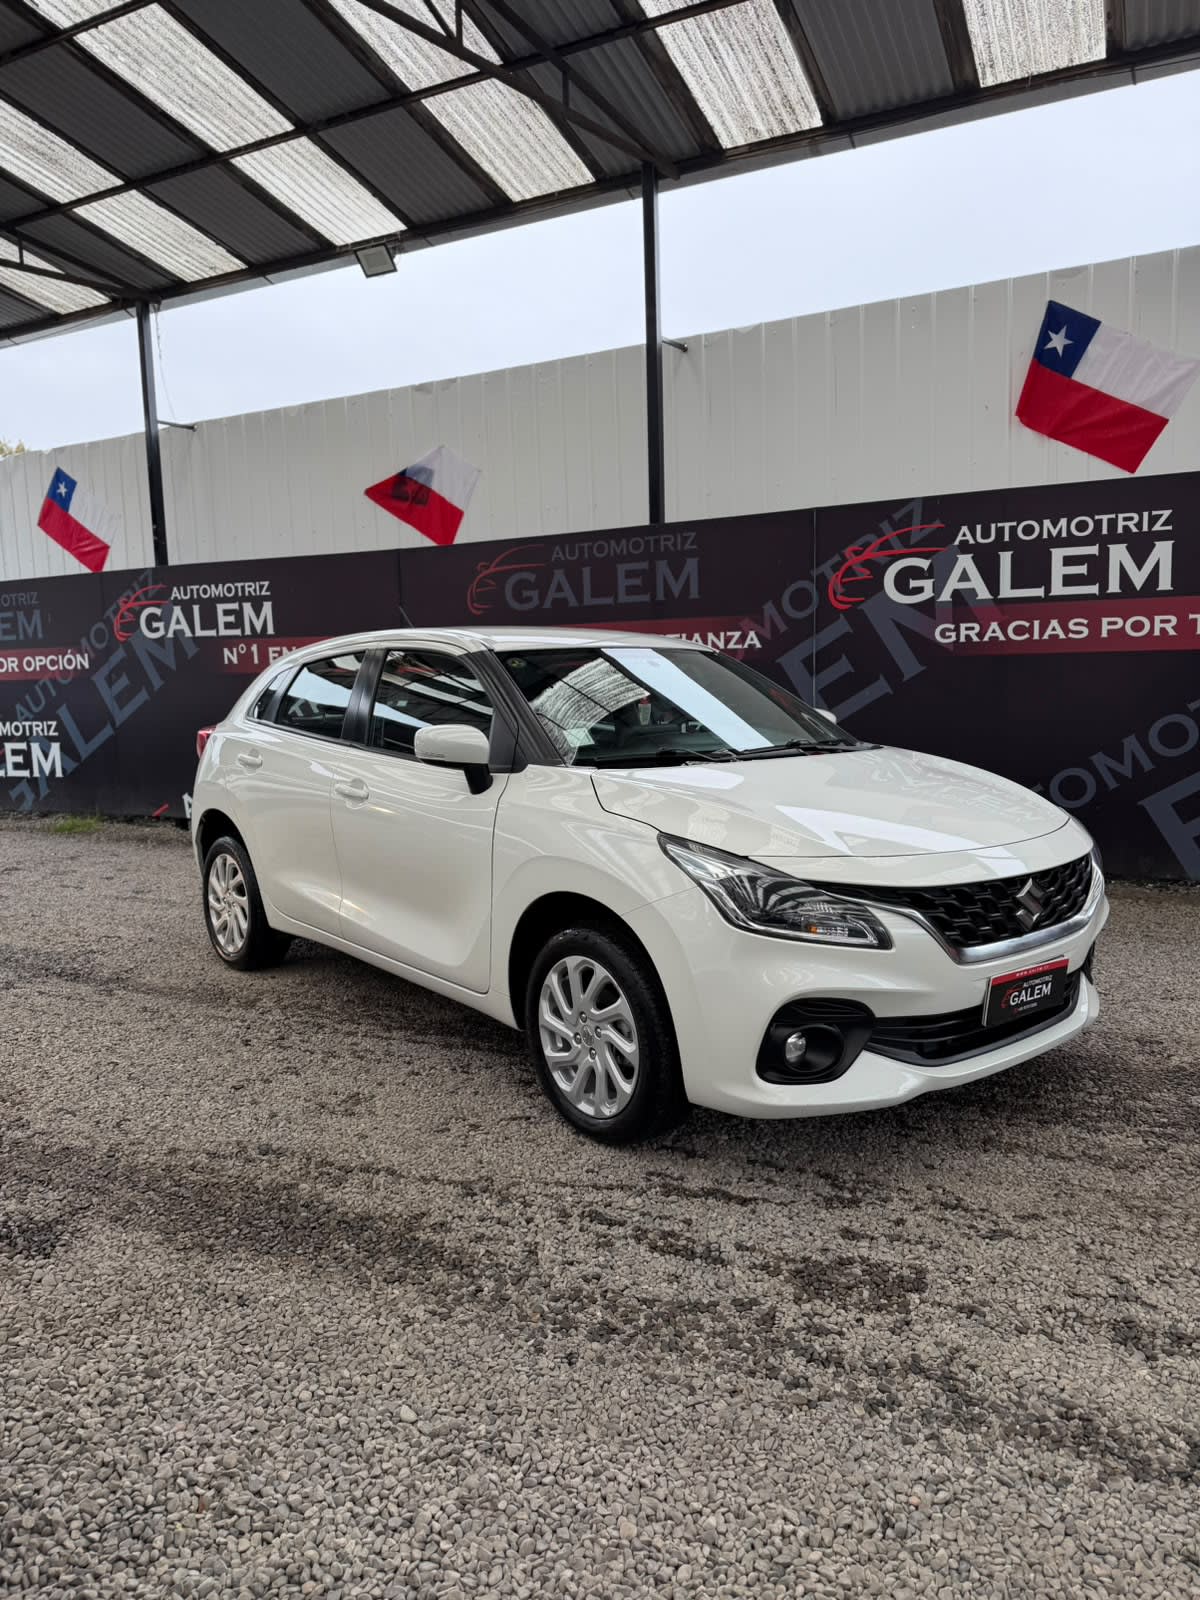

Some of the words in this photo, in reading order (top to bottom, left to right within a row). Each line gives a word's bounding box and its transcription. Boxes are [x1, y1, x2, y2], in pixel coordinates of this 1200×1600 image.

[953, 509, 1173, 546] AUTOMOTRIZ
[552, 532, 697, 562] AUTOMOTRIZ
[505, 558, 700, 611] GALEM
[883, 540, 1175, 605] GALEM
[171, 581, 270, 600] AUTOMOTRIZ
[139, 602, 275, 639] GALEM
[934, 618, 1089, 643] GRACIAS
[1100, 615, 1178, 638] POR
[23, 649, 90, 672] OPCIÓN
[1010, 982, 1052, 1005] GALEM
